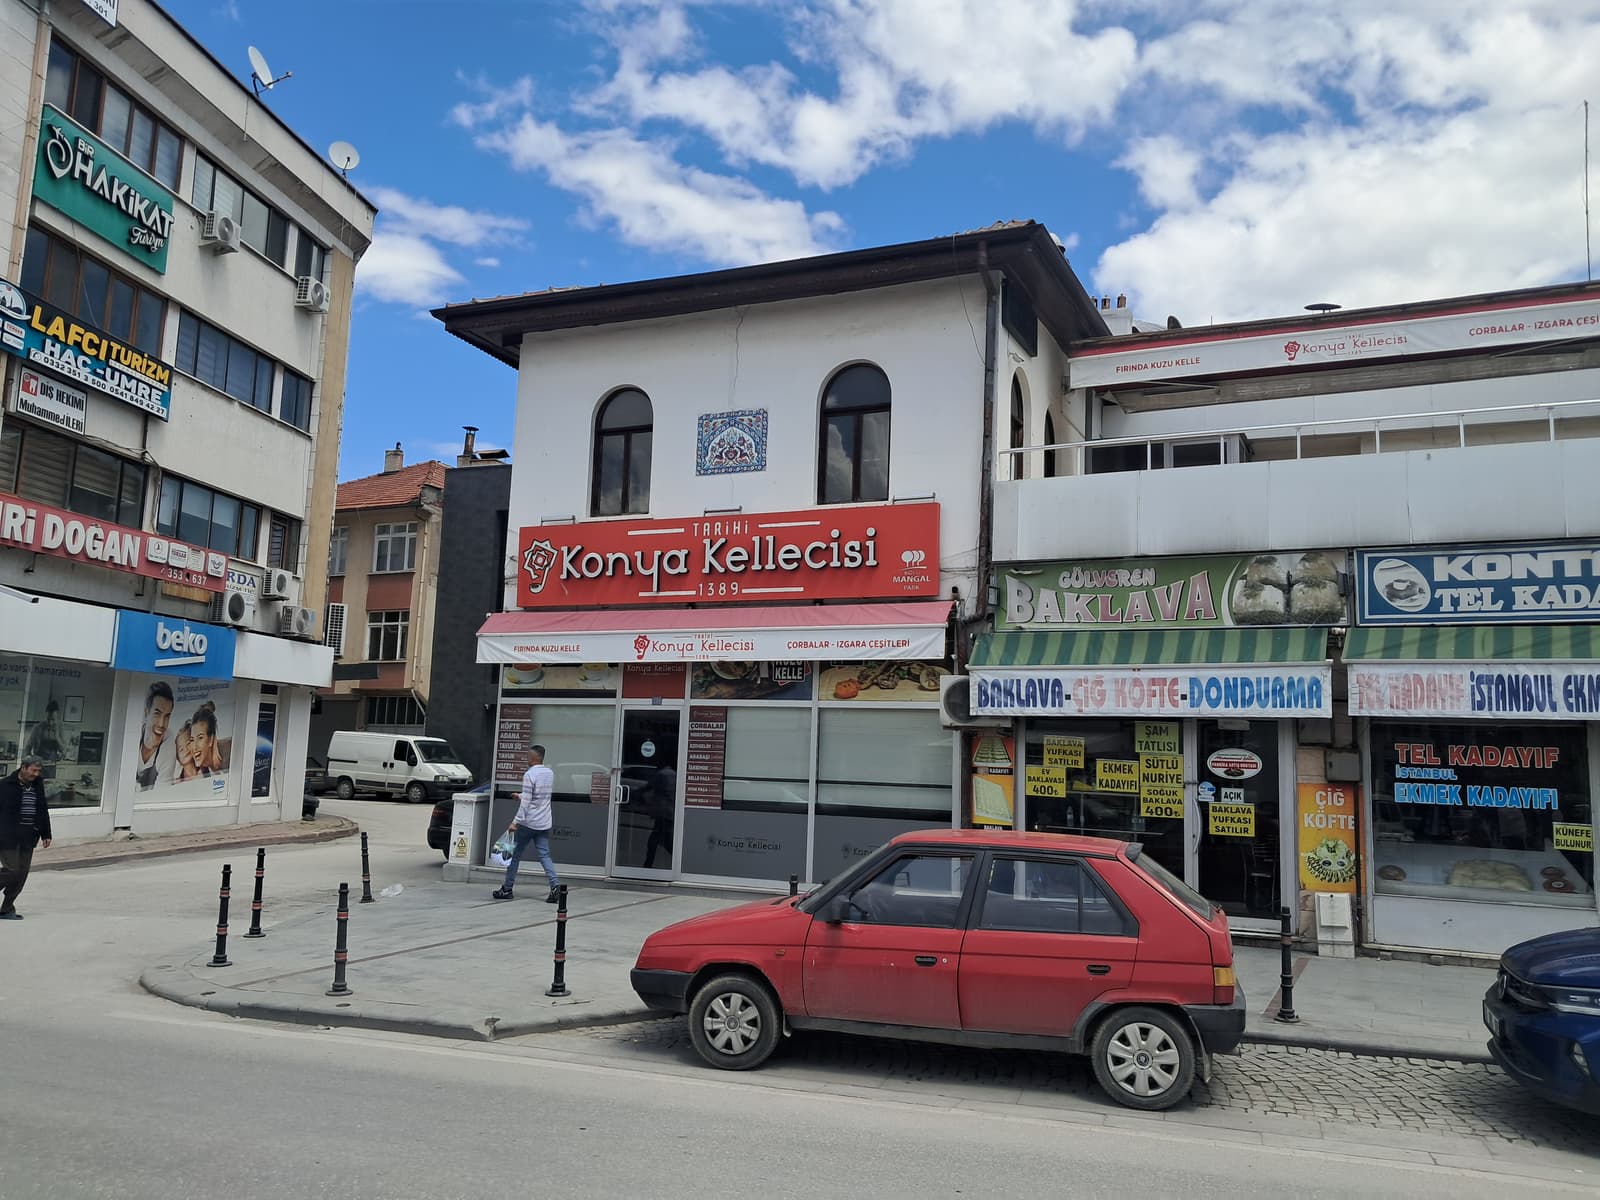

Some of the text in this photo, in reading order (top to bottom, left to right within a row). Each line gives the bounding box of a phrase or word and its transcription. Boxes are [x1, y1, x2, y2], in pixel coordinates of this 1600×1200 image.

[77, 138, 95, 157] BİR
[74, 151, 174, 238] HAKİKAT
[1469, 322, 1525, 337] ÇORBALAR
[1534, 318, 1573, 330] IZGARA
[31, 304, 107, 361] LAFCI
[110, 340, 170, 385] TURİZM
[1302, 335, 1408, 355] Konya Kellecisi
[1115, 357, 1201, 373] FIRINDA KUZU KELLE
[40, 381, 85, 412] DİŞ HEKİMİ
[19, 398, 84, 432] Muhammed İLERİ
[693, 520, 749, 537] TARİHİ
[41, 512, 141, 569] DOĞAN
[559, 527, 879, 593] Konya Kellecisi
[167, 568, 183, 580] 353
[192, 574, 207, 586] 637
[892, 574, 932, 584] MANGAL
[698, 581, 739, 596] 1389
[1004, 569, 1217, 625] BAKLAVA
[1434, 586, 1504, 612] TEL
[156, 620, 208, 656] beko
[787, 640, 829, 650] ÇORBALAR
[836, 639, 866, 649] IZGARA
[868, 638, 910, 649] ÇEŞİTLERİ
[513, 643, 581, 653] FIRINDA KUZU KELLE
[652, 638, 755, 657] Konya Kellecisi
[626, 663, 684, 675] Konya Kellecisi
[775, 667, 803, 680] KELLE
[1469, 670, 1557, 713] İSTANBUL
[1145, 725, 1169, 738] ŞAM
[1046, 738, 1083, 748] BAKLAVA
[1136, 740, 1177, 752] TATLISI
[1046, 747, 1082, 757] YUFKASI
[1394, 743, 1560, 769] TEL KADAYIF
[1047, 758, 1080, 767] SATILIR
[1102, 762, 1134, 775] EKMEK
[1145, 757, 1179, 770] SÜTLÜ
[1142, 771, 1182, 784] NURİYE
[1395, 764, 1458, 780] İSTANBUL
[1027, 775, 1065, 784] BAKLAVASI
[1098, 778, 1137, 790] KADAYIFI
[1146, 788, 1178, 797] SOĞUK
[1223, 790, 1242, 803] AÇIK
[1315, 787, 1345, 810] ÇİĞ
[1394, 782, 1559, 810] EKMEK KADAYIFI
[1142, 797, 1183, 805] BAKLAVA
[1211, 805, 1252, 814] BAKLAVA
[1212, 815, 1251, 824] YUFKASI
[1303, 809, 1355, 830] KÖFTE
[1214, 825, 1249, 834] SATILIR
[1555, 825, 1591, 838] KÜNEFE
[717, 838, 782, 851] Konya Kellecisi
[1555, 837, 1592, 849] BULUNUR
